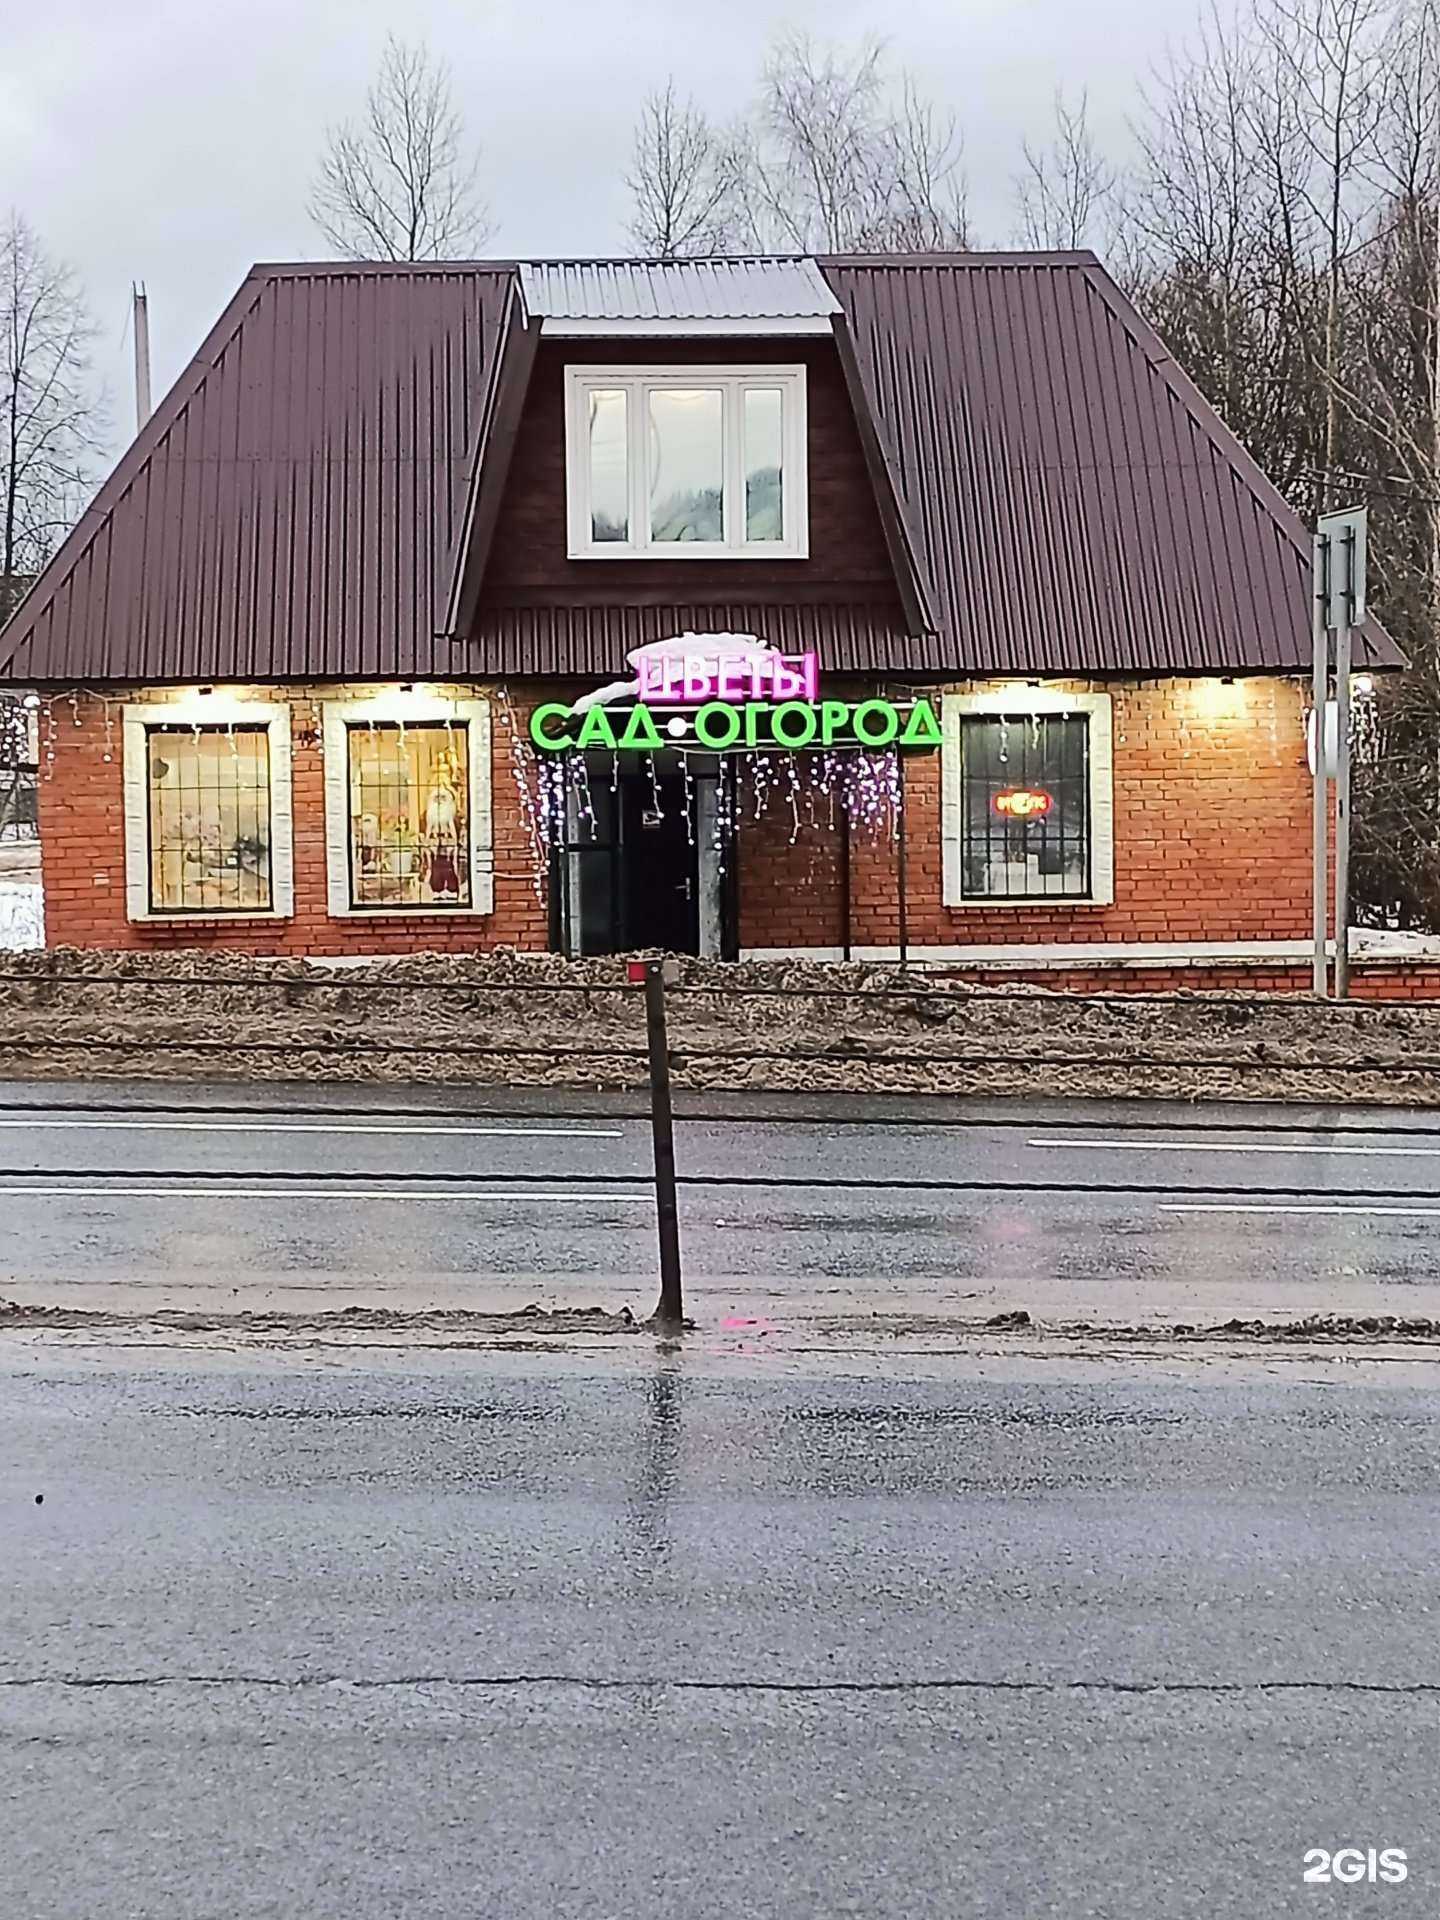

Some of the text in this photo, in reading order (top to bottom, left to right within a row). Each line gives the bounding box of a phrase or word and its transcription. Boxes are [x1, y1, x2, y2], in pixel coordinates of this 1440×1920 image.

[639, 651, 817, 700] ЦВЕТЫ
[530, 699, 943, 750] САД ОГОРОД
